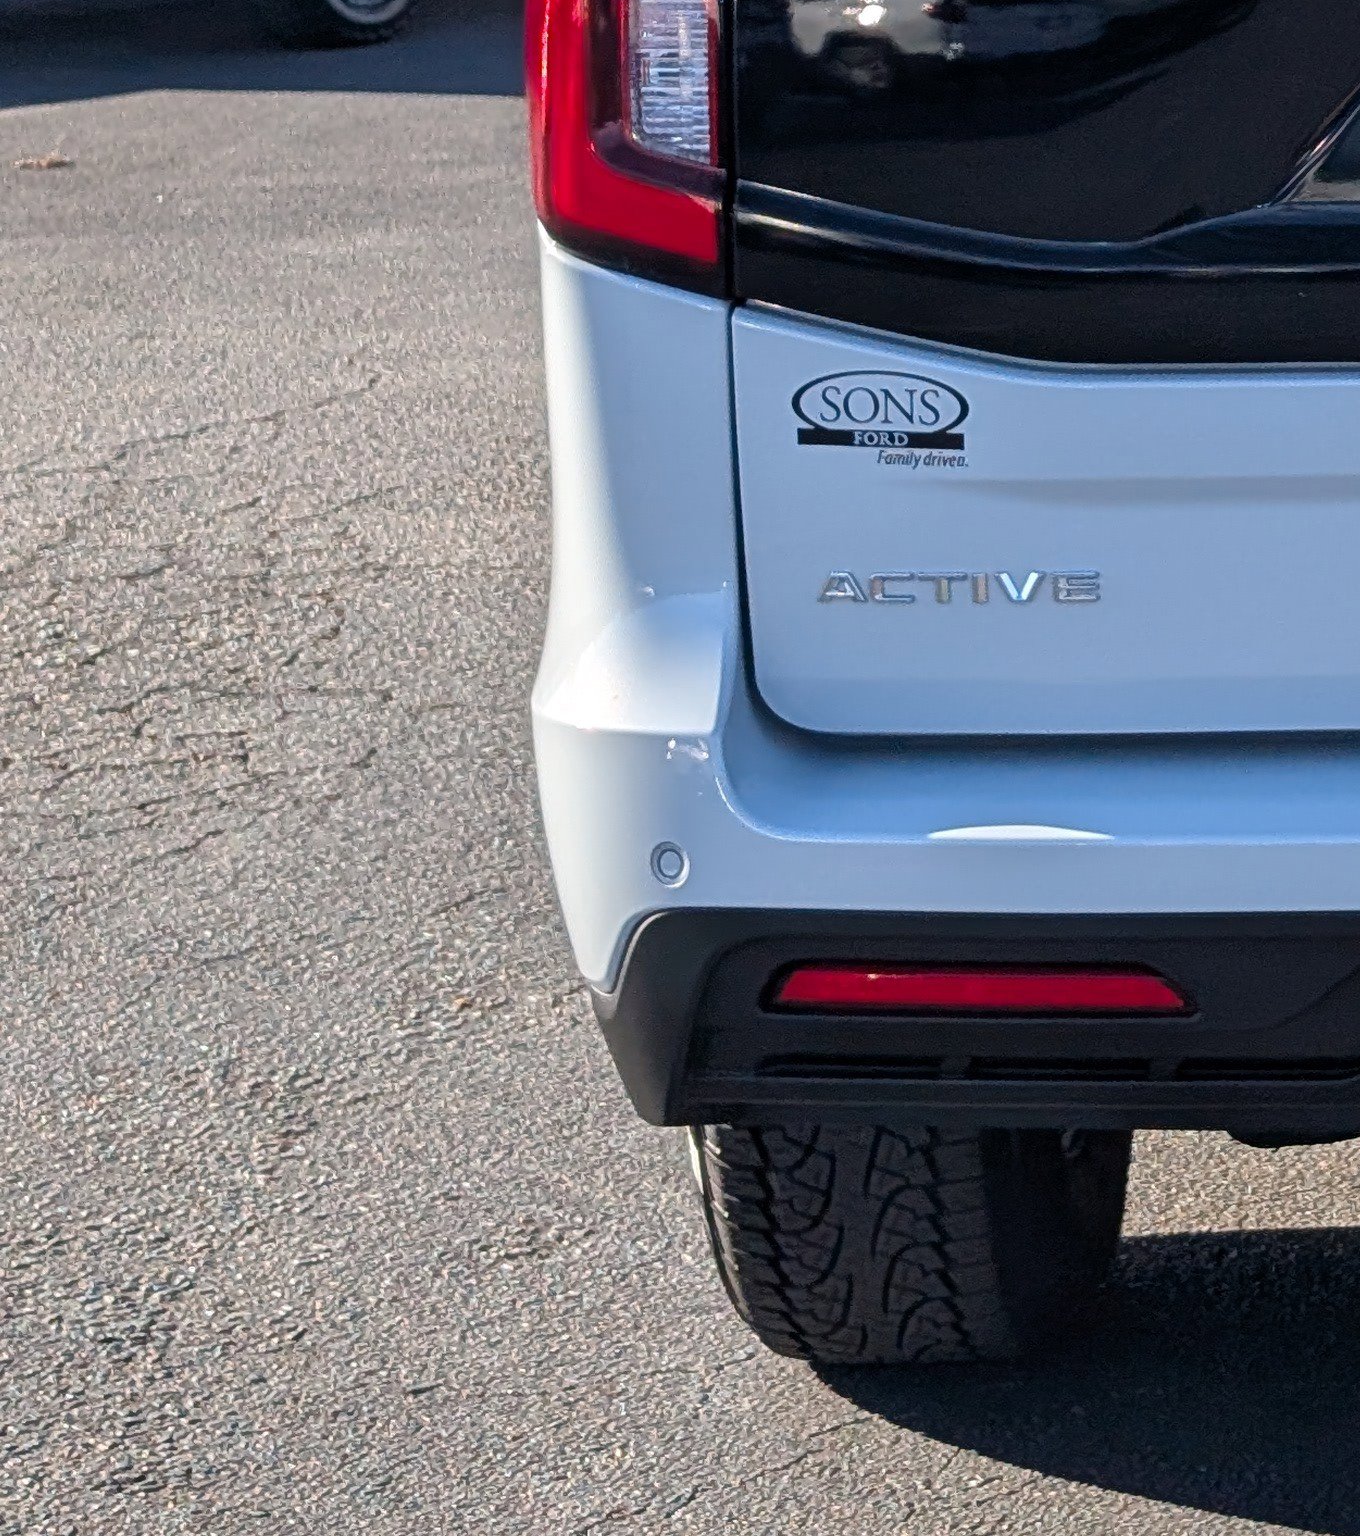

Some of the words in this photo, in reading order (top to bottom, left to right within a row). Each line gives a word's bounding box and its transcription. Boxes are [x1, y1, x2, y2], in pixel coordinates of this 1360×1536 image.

[819, 385, 941, 426] SONS
[853, 431, 909, 447] FORD
[877, 449, 920, 470] Family
[922, 452, 970, 468] driven.
[817, 569, 1102, 604] ACTIVE
